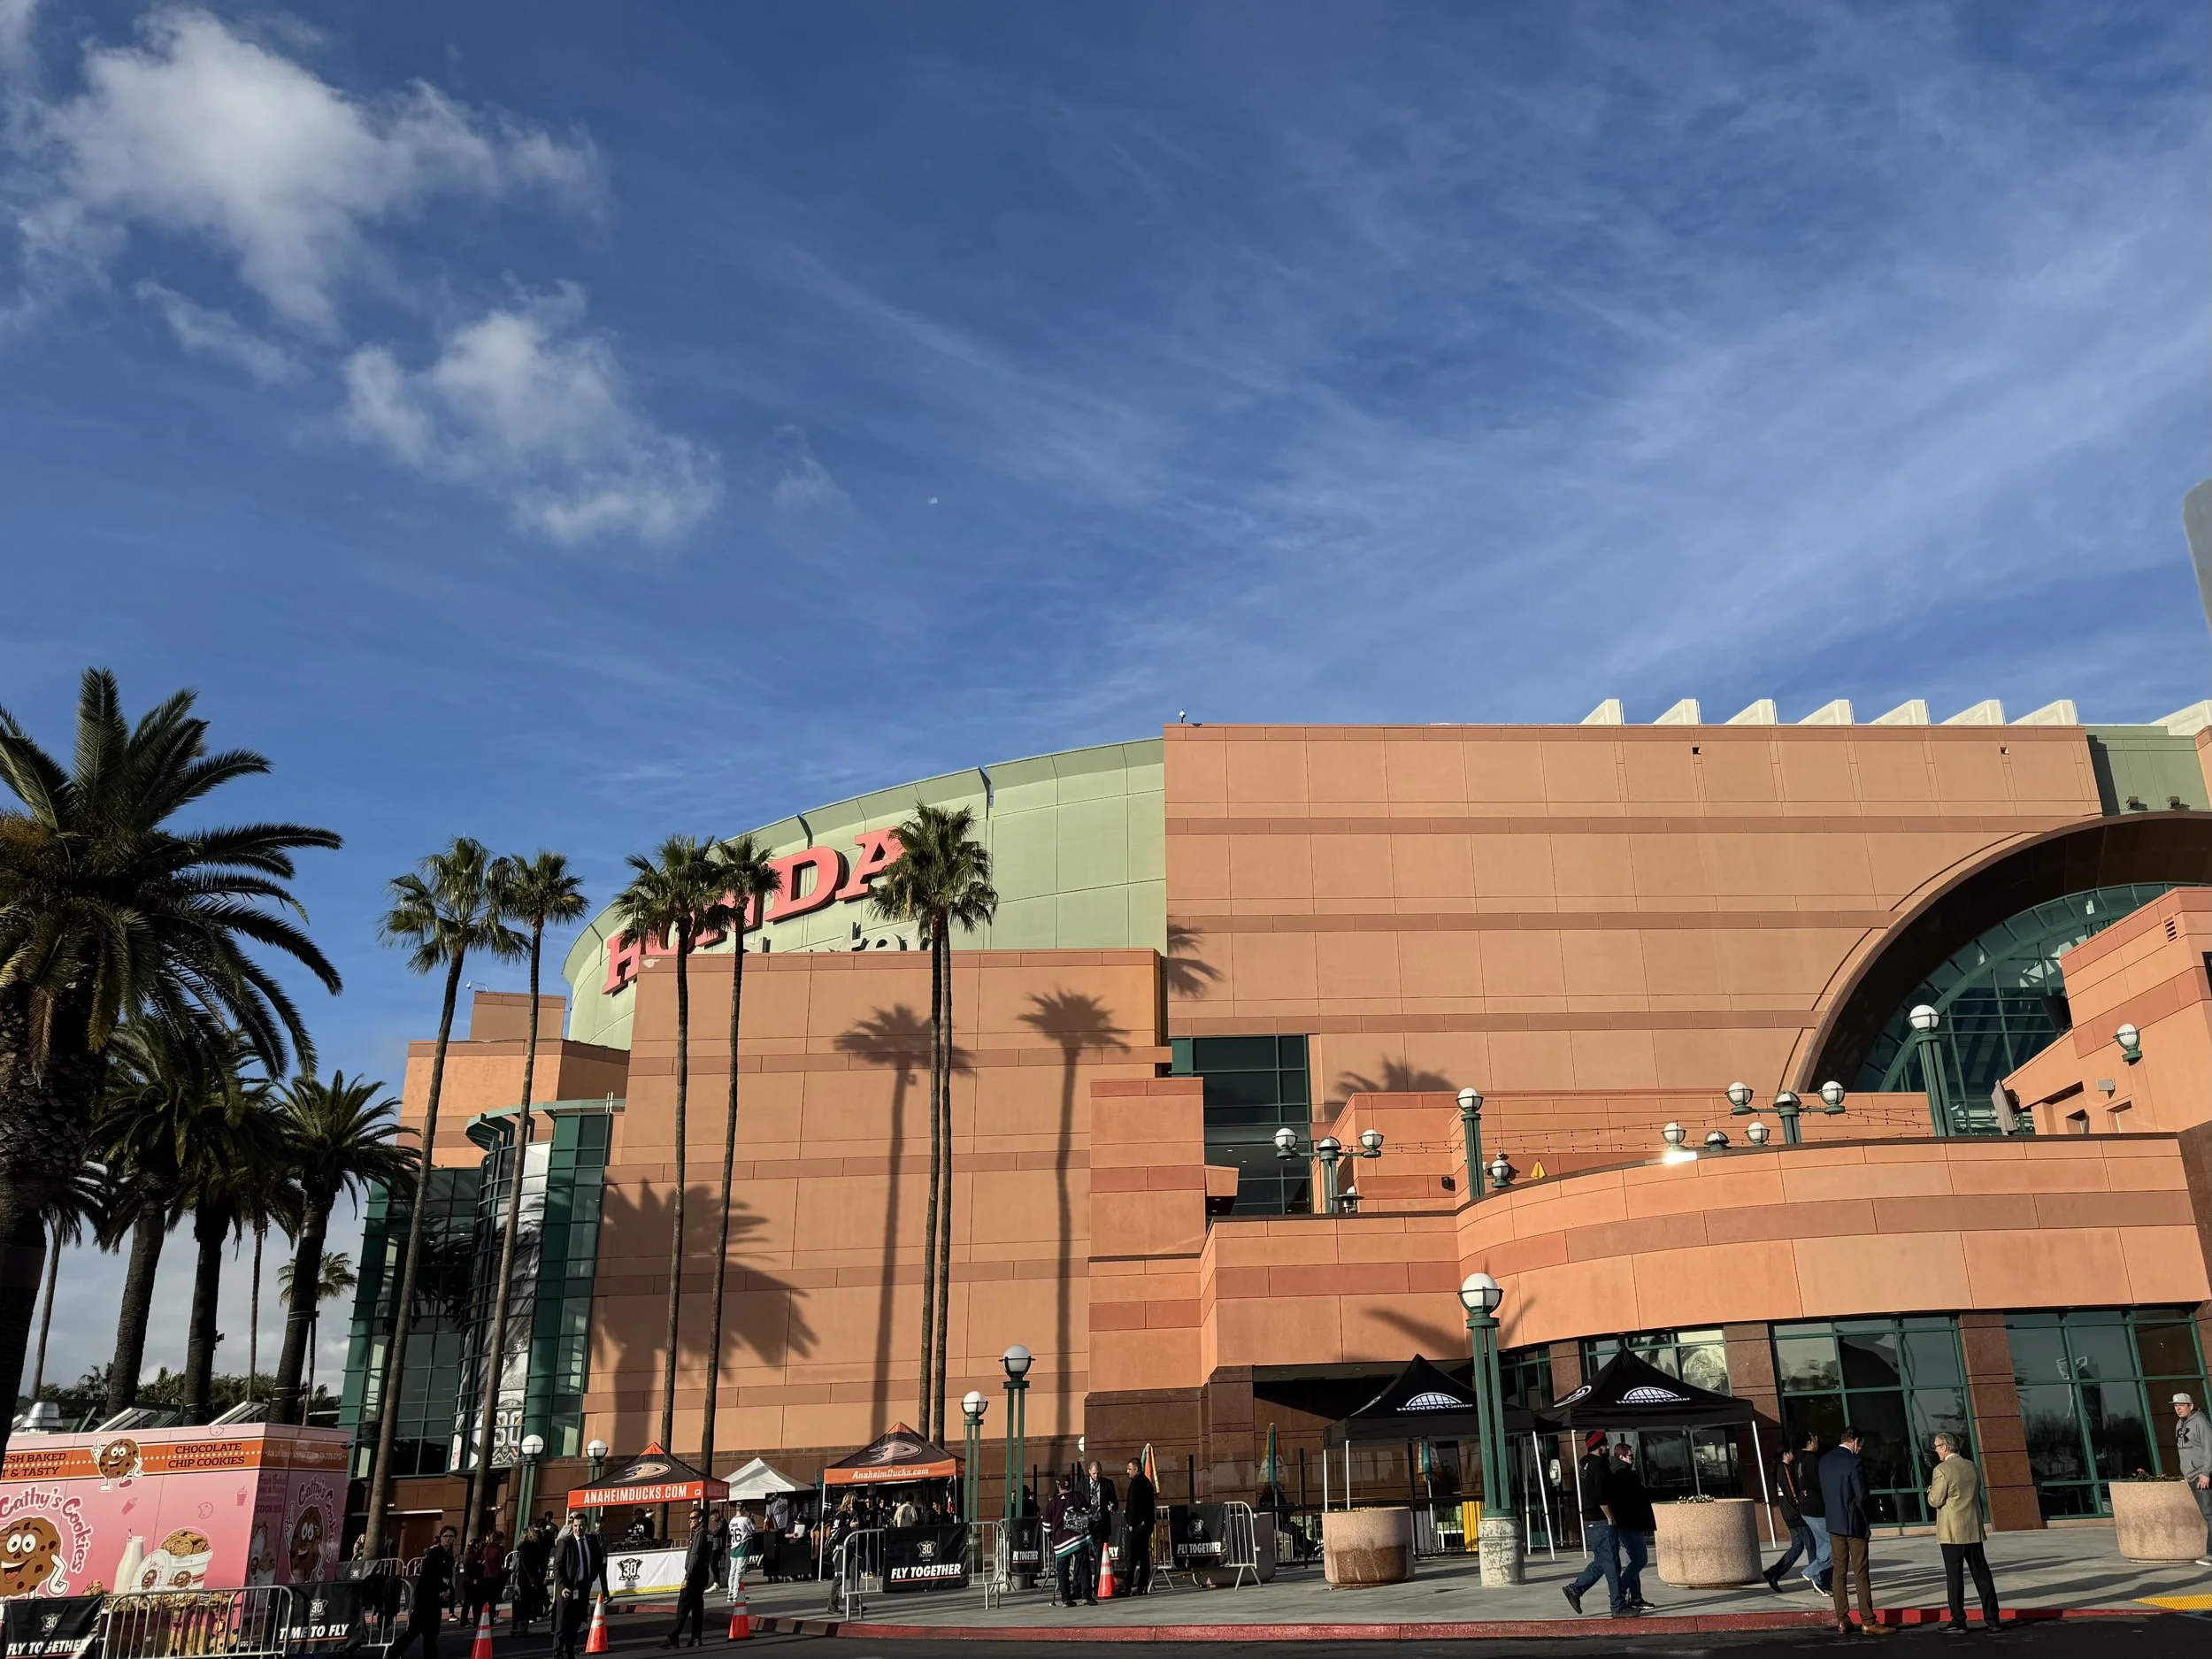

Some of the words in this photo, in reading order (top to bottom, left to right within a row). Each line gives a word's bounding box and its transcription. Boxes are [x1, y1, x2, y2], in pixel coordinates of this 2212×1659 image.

[175, 1442, 242, 1454] CHOCOLATE
[4, 1455, 25, 1463] ESH
[27, 1452, 66, 1463] BAKED
[168, 1459, 195, 1468] CHIP
[196, 1456, 245, 1466] COOKIES
[11, 1468, 19, 1477] &
[22, 1466, 60, 1476] TASTY
[852, 1468, 929, 1479] AnaheimDucks.com
[583, 1485, 687, 1504] ANAHEIMDUCKS.COM
[0, 1486, 63, 1518] Cathy's
[62, 1497, 92, 1573] Cookies
[922, 1543, 932, 1555] 30
[1178, 1543, 1188, 1555] FLY
[623, 1563, 637, 1578] 30
[891, 1567, 909, 1579] FLY
[910, 1563, 961, 1578] TOGETHER
[311, 1601, 323, 1613] 30
[46, 1617, 58, 1628] 30
[311, 1625, 326, 1638] TO
[328, 1624, 349, 1636] FLY
[6, 1642, 27, 1655] FLY
